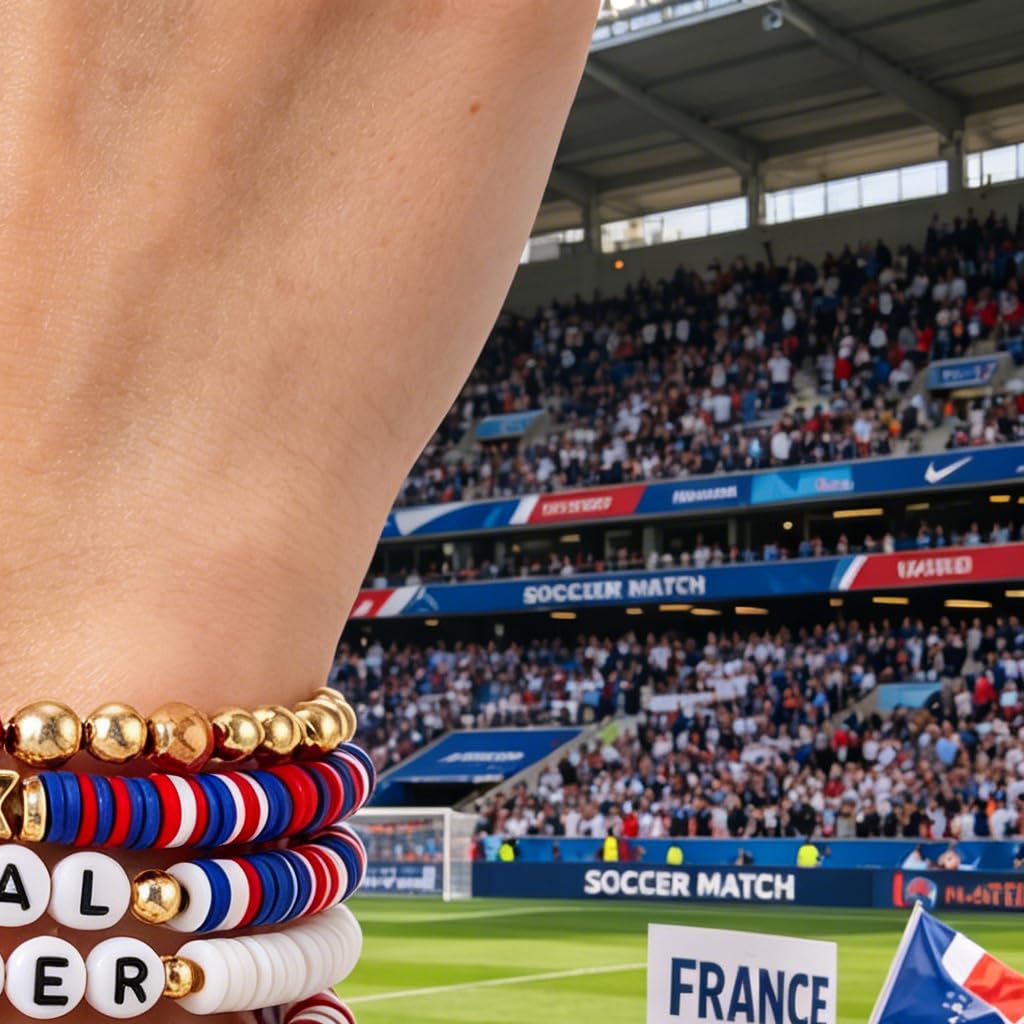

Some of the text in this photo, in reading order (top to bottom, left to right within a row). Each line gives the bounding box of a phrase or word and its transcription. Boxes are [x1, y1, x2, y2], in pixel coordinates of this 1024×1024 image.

[628, 575, 706, 598] MATCH
[584, 869, 795, 900] SOCCER MATCH
